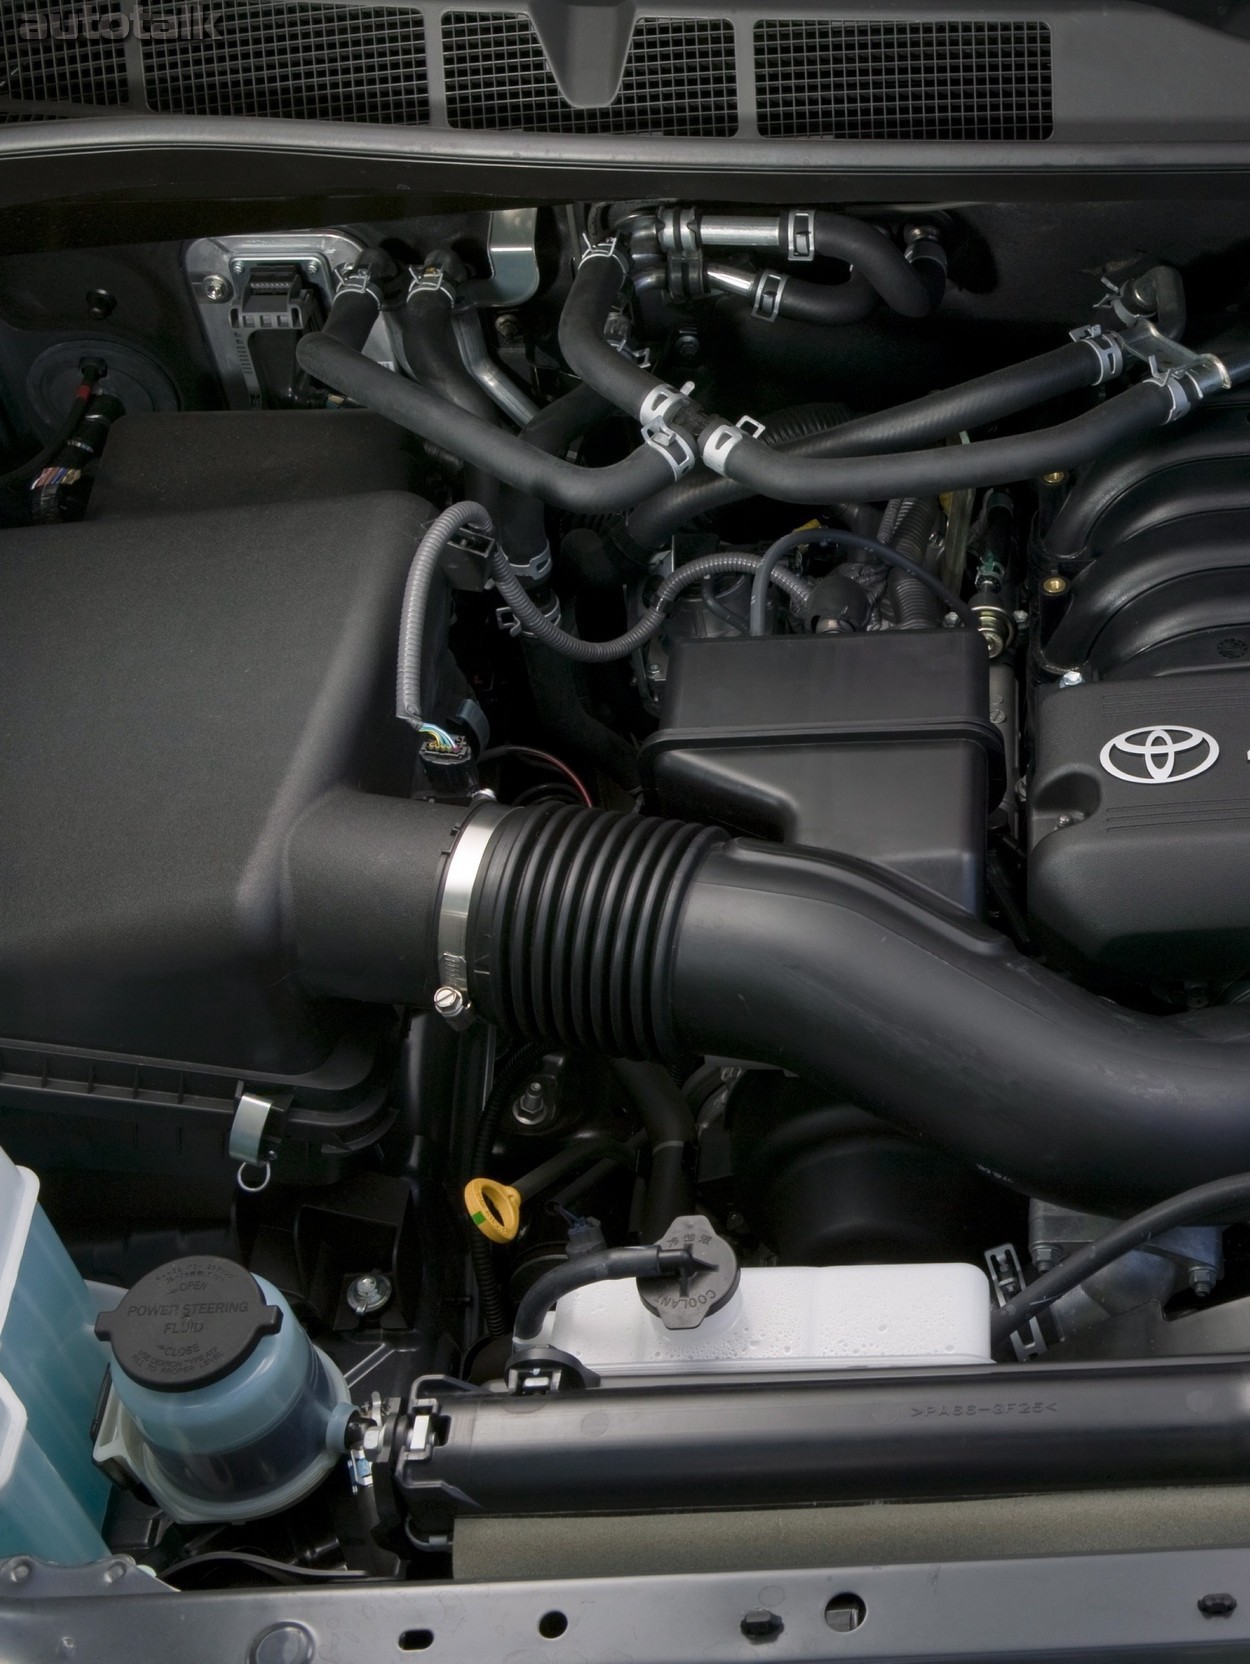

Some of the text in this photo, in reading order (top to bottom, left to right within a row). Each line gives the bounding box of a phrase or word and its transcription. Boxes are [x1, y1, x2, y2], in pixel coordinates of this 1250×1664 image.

[180, 1280, 208, 1292] OPEN
[653, 1289, 716, 1309] COOLANT
[127, 1302, 249, 1317] POWER STEERING
[163, 1322, 204, 1334] FLUID
[165, 1343, 201, 1357] CLOSE
